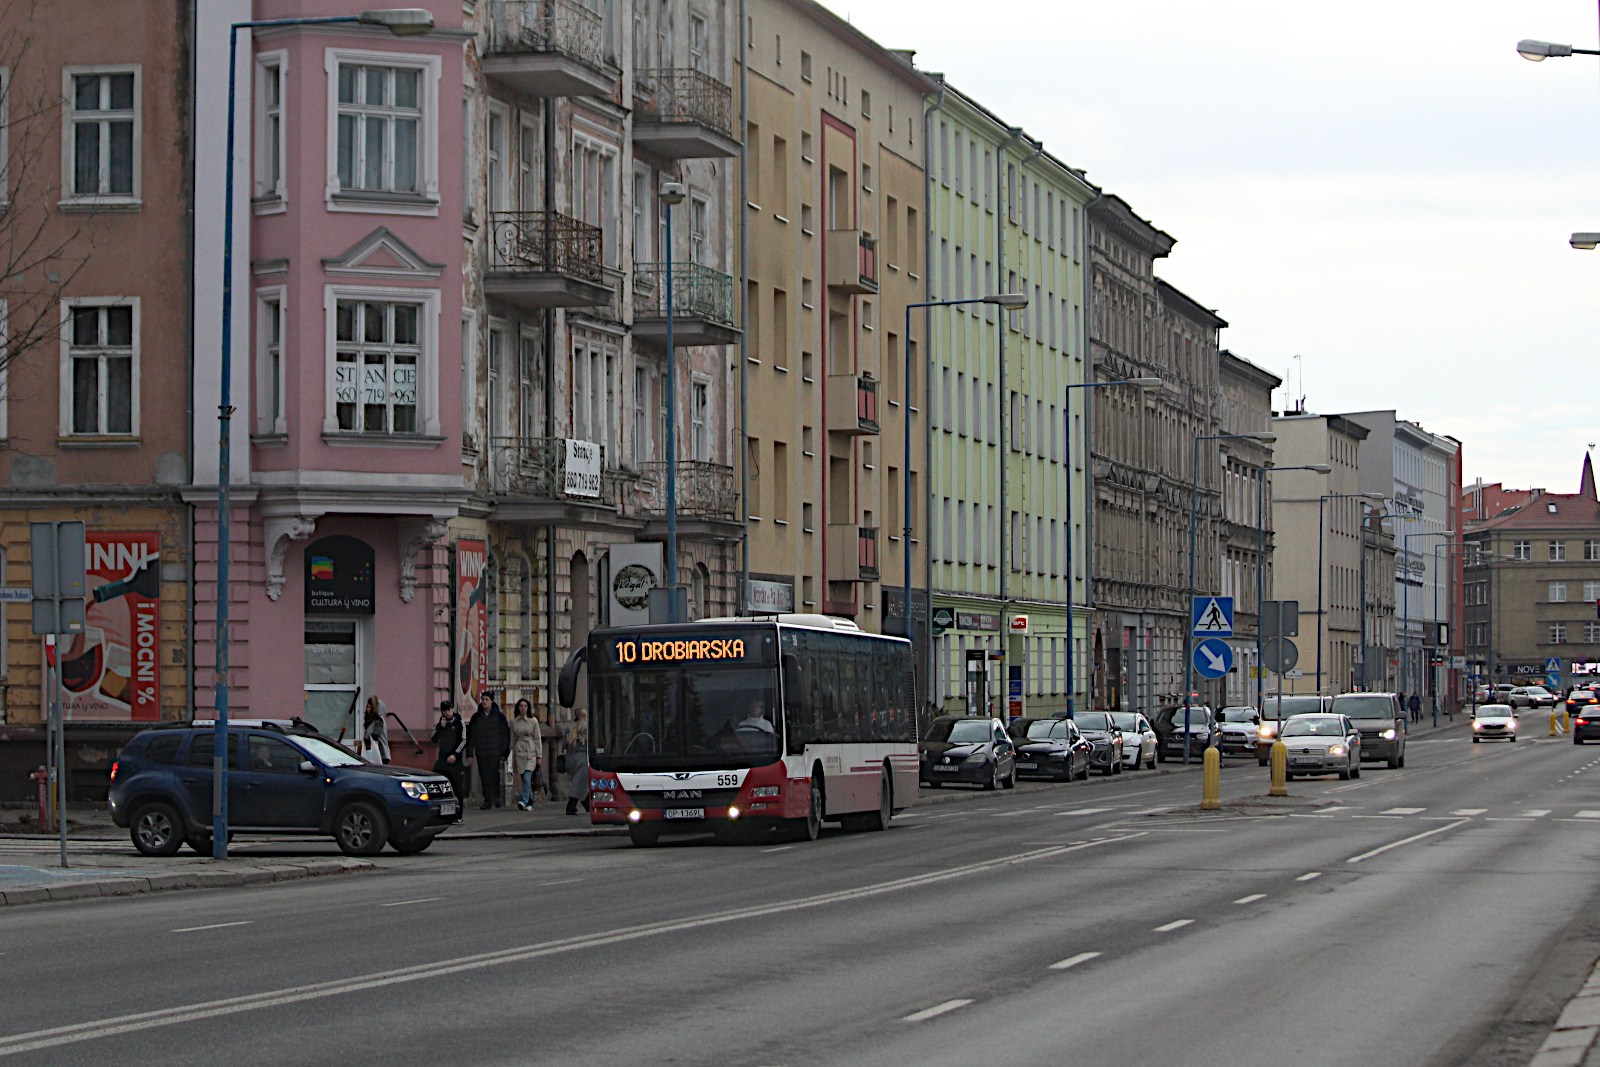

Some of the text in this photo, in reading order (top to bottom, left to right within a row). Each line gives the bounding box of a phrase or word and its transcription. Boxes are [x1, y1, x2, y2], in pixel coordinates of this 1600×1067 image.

[366, 389, 385, 403] 719
[394, 389, 415, 403] 962
[573, 441, 593, 464] Stancje
[567, 471, 577, 488] 660
[85, 543, 148, 570] INNI
[460, 550, 483, 577] WINNI
[137, 613, 155, 682] MOCNI
[616, 639, 745, 663] 10 DROBIARSKA
[717, 774, 738, 786] 559
[663, 790, 702, 799] MAN
